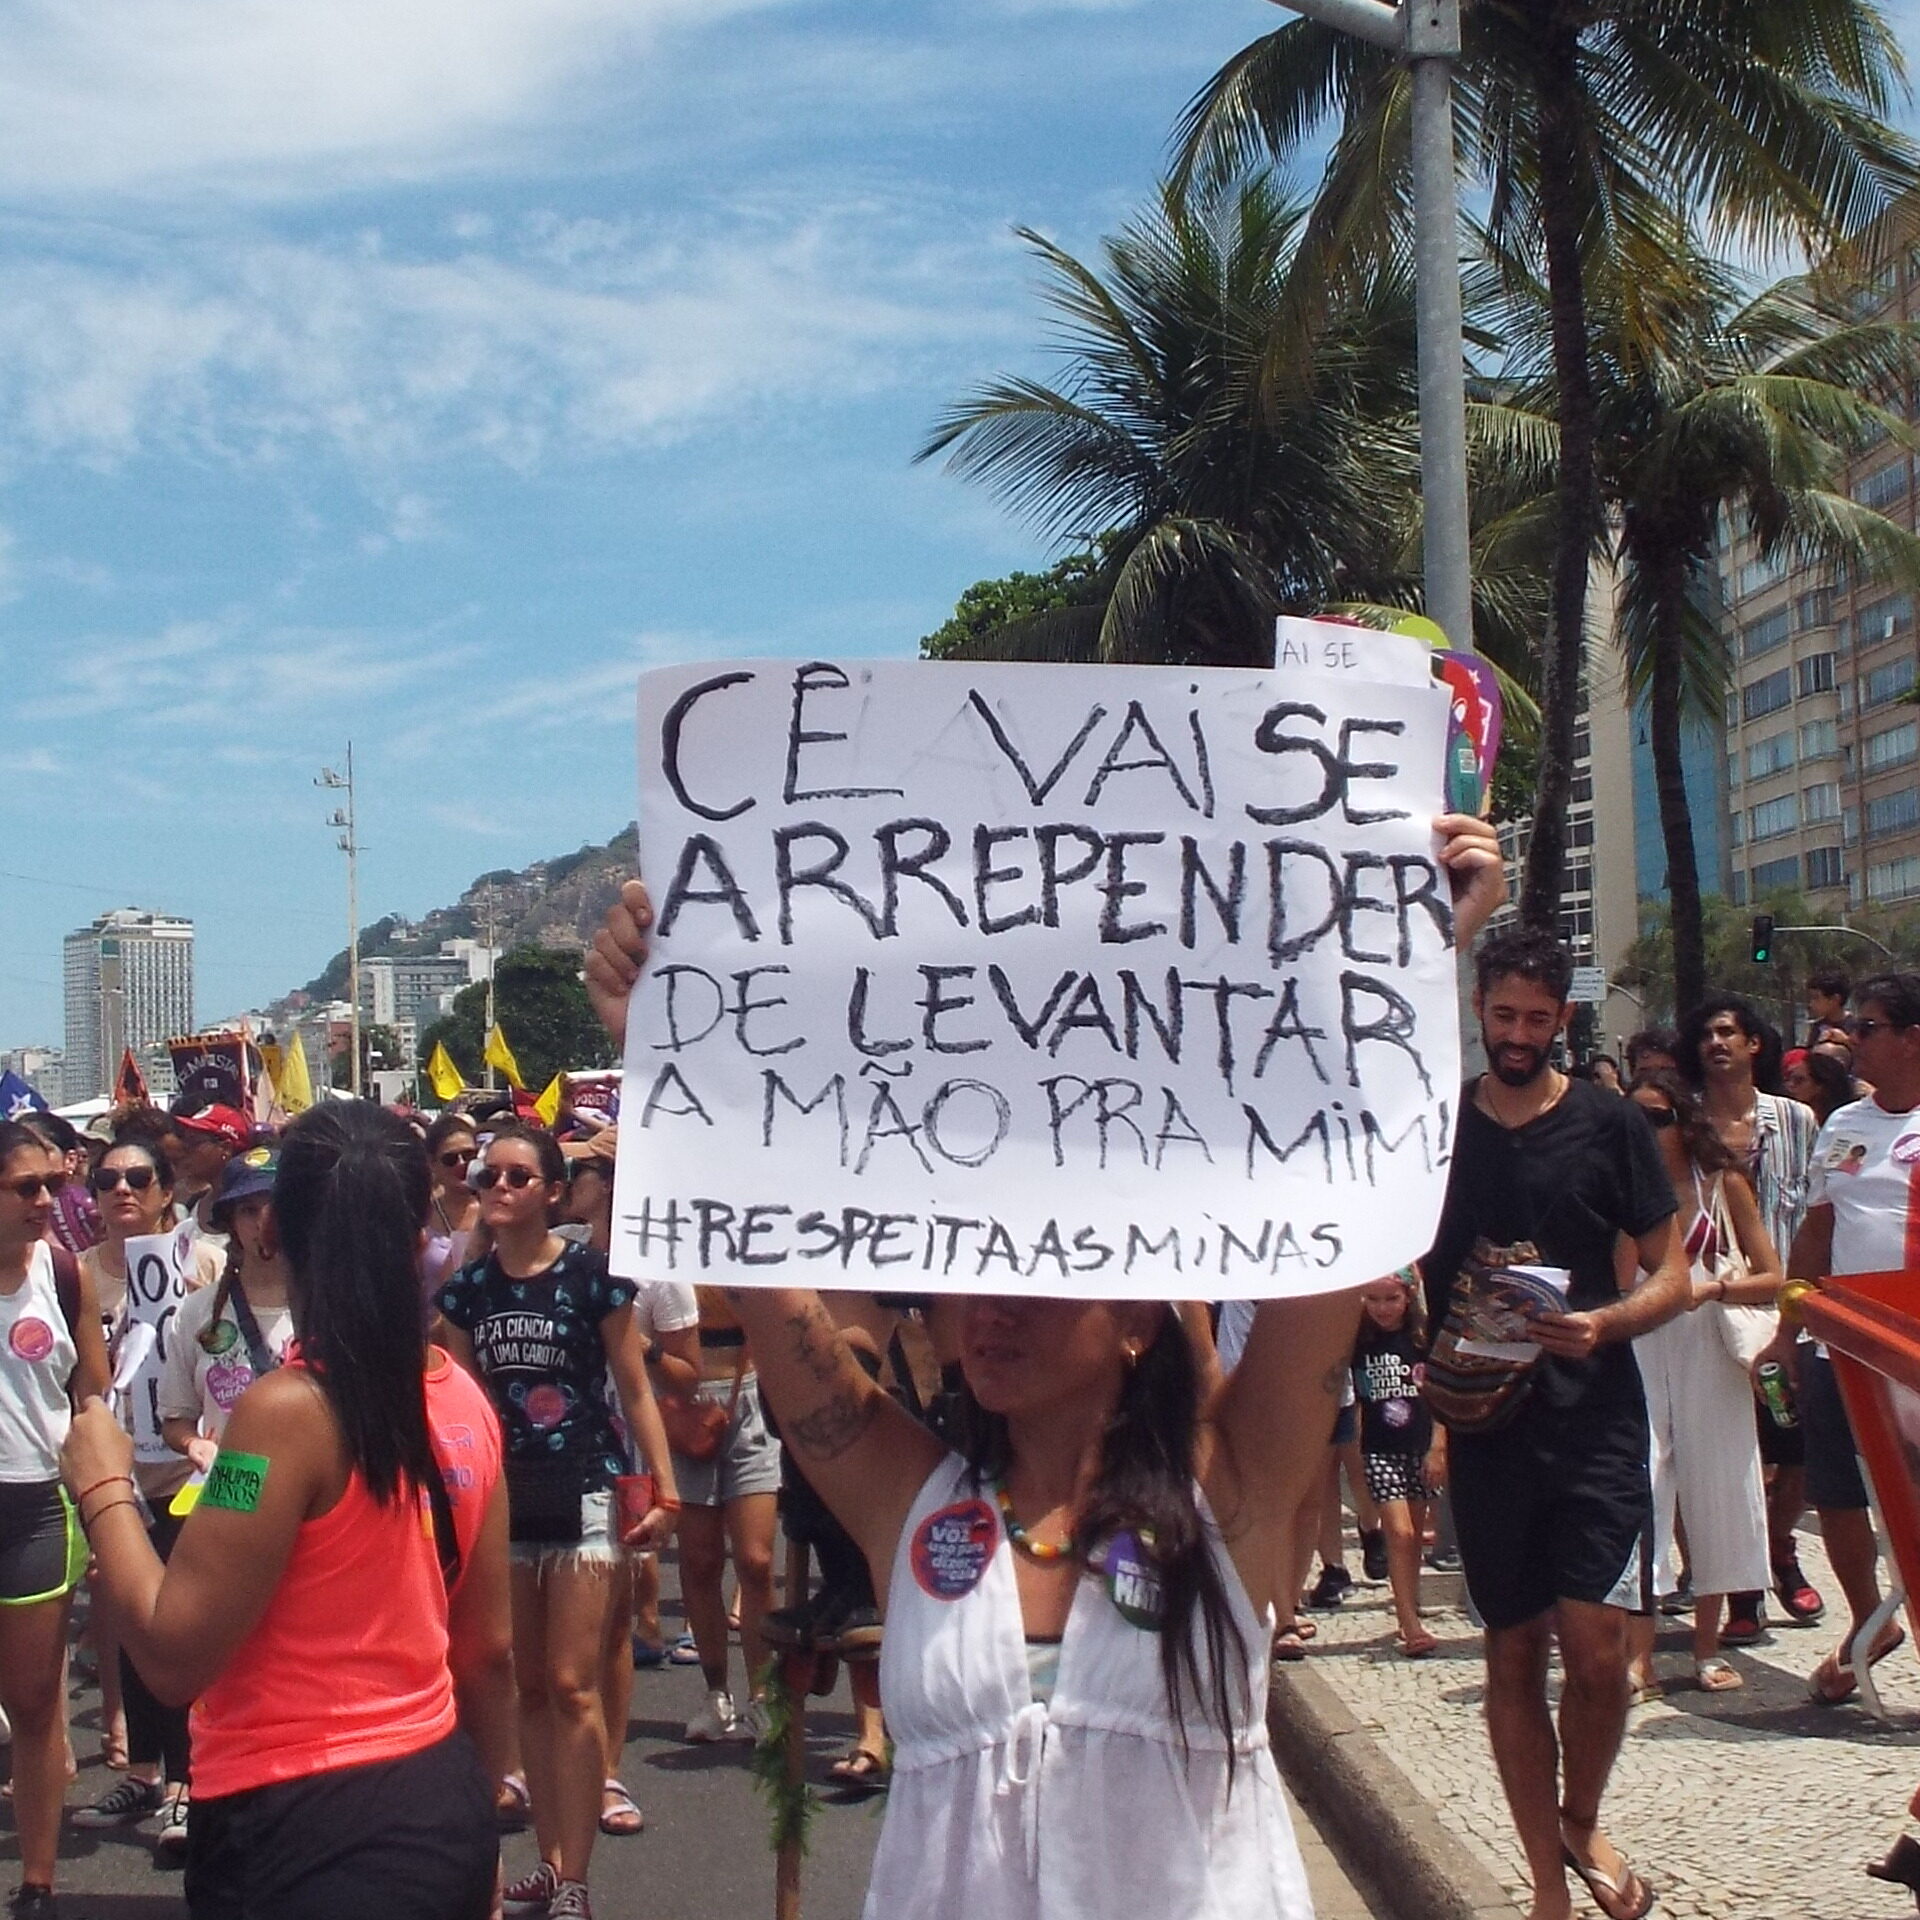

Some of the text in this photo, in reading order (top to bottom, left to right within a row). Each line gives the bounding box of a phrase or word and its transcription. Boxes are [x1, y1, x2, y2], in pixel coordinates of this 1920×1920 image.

[1323, 641, 1360, 669] SE
[1244, 700, 1412, 826] SE
[657, 817, 1457, 970] ARREPENDER
[650, 963, 1434, 1100] DE LEVANTAR
[641, 1062, 715, 1129] A
[760, 1061, 1012, 1176] MÃO
[1038, 1073, 1216, 1171] PRA
[492, 1342, 520, 1365] UMA
[521, 1342, 567, 1368] GAROTA
[1365, 1352, 1401, 1368] Lute
[1366, 1364, 1411, 1378] como
